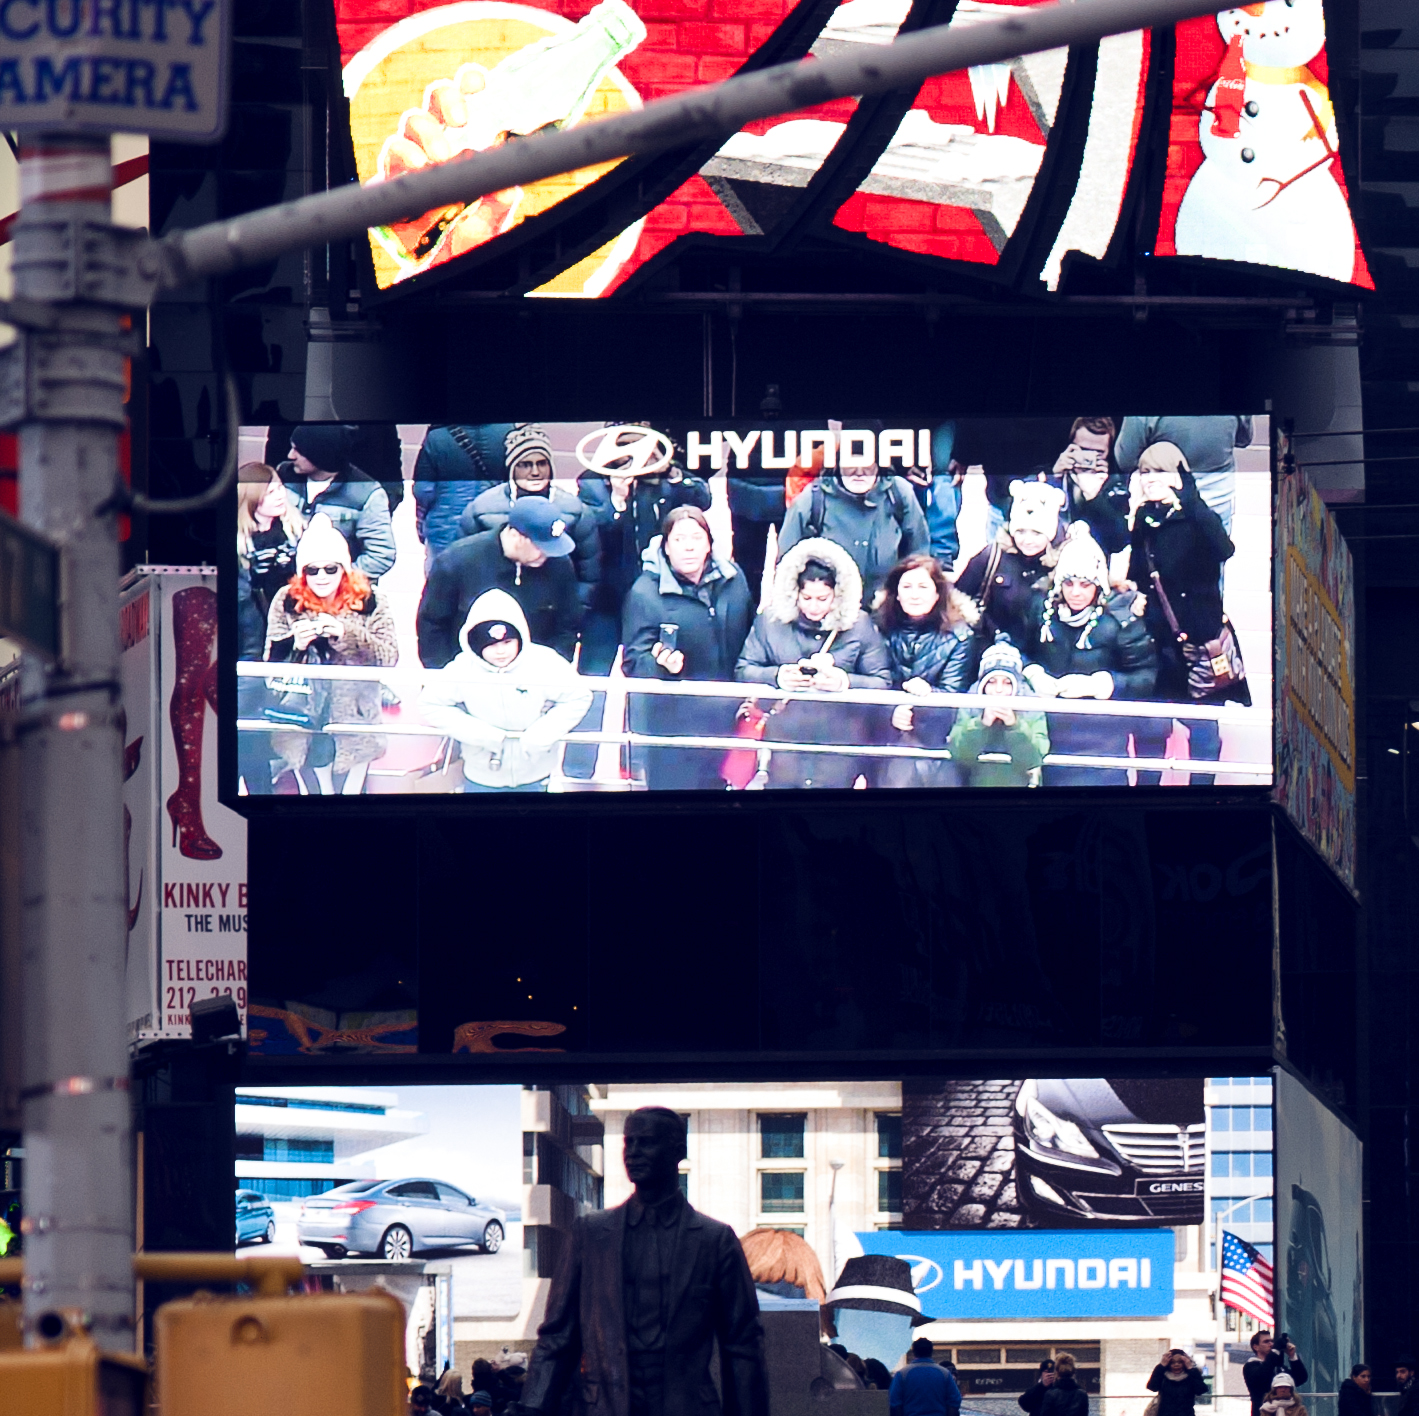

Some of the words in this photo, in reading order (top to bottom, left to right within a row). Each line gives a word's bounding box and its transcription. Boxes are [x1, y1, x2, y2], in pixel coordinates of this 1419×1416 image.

[687, 429, 931, 470] HYUNDAI
[164, 882, 230, 908] KINKY
[184, 914, 213, 932] THE
[953, 1258, 1151, 1290] HYUNDAI
